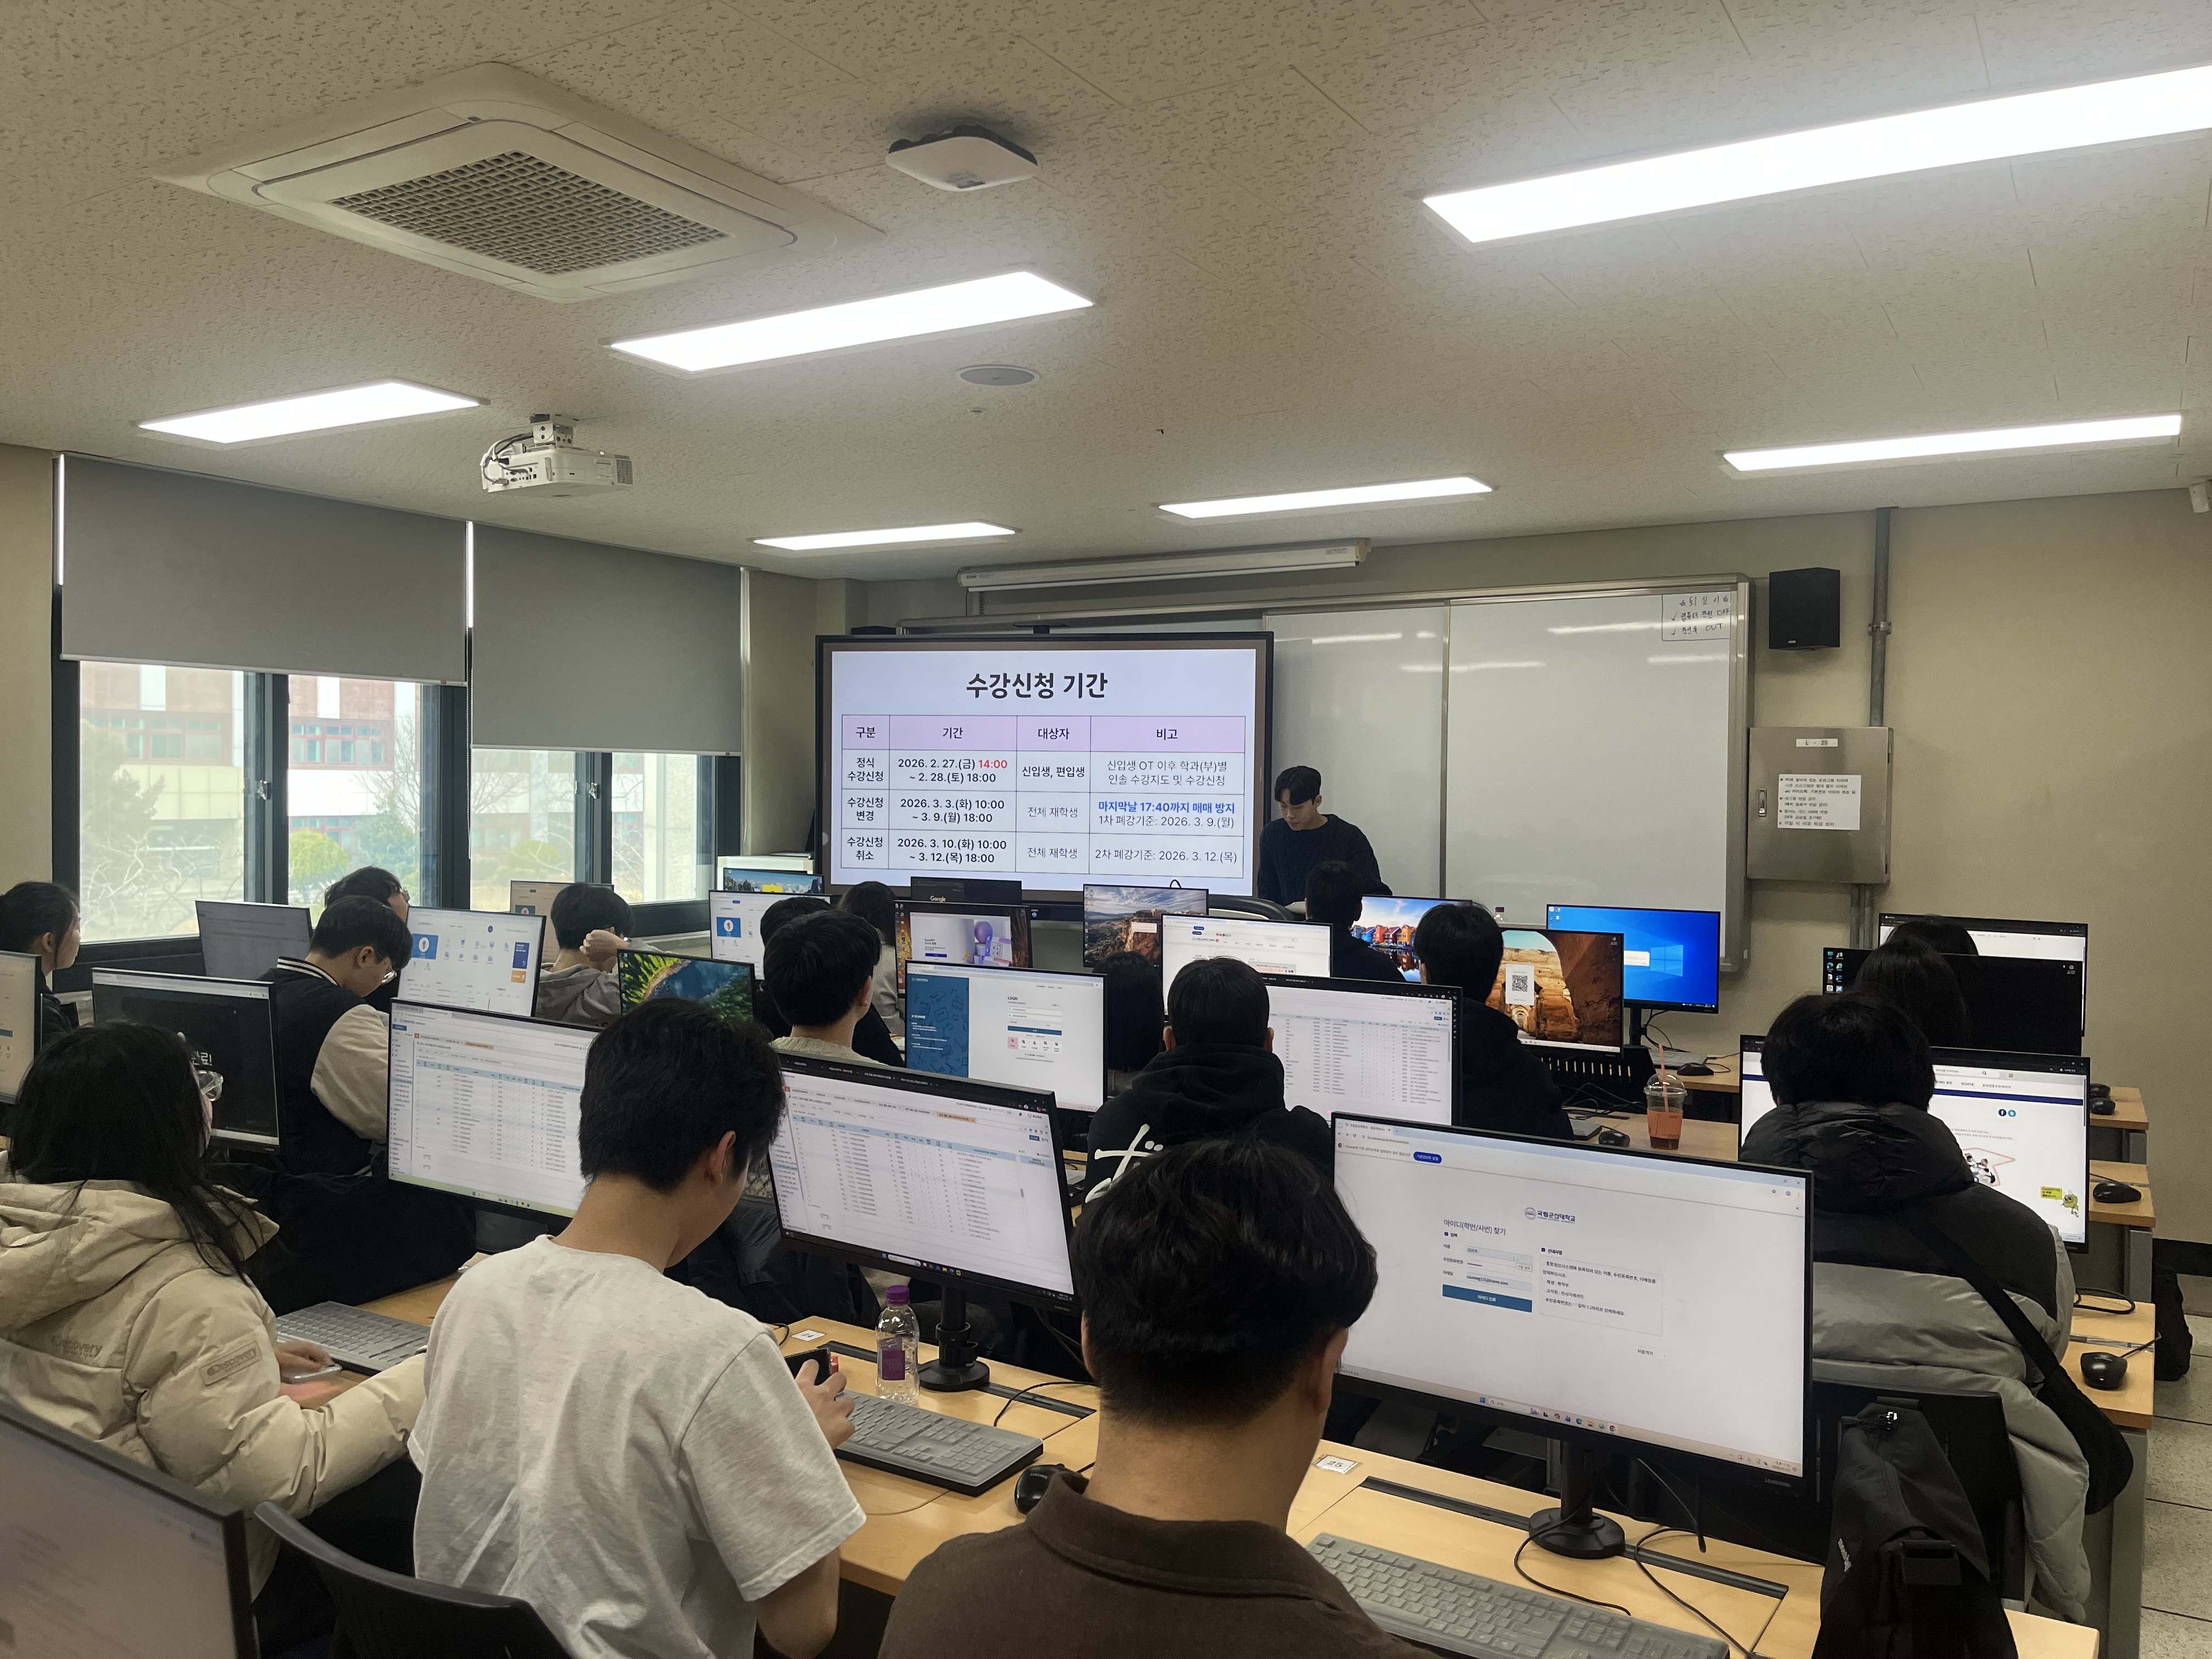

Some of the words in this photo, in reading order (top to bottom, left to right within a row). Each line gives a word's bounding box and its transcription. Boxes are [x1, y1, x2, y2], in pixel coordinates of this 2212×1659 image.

[967, 673, 1053, 699] 수강신청
[1063, 673, 1108, 698] 기간
[856, 727, 876, 738] 구분
[943, 727, 963, 738] 기간
[1038, 728, 1069, 740] 대상자
[1157, 729, 1178, 740] 비고
[857, 758, 874, 768] 정식
[898, 759, 927, 768] 2026.
[930, 759, 939, 768] 2.
[943, 759, 975, 770] 27.(금)
[979, 760, 1007, 768] 14:00
[1108, 760, 1135, 771] 신입생
[1139, 761, 1154, 770] OT
[1158, 761, 1176, 771] 이후
[1180, 761, 1226, 773] 학과(부)별
[848, 771, 883, 781] 수강신청
[1022, 766, 1053, 778] 신입생,
[1056, 766, 1084, 777] 편입생
[919, 773, 927, 781] 2.
[930, 773, 963, 784] 28.(토)
[967, 774, 996, 782] 18:00
[1109, 775, 1127, 785] 인솔
[1131, 775, 1170, 785] 수강지도
[1173, 775, 1182, 786] 및
[1186, 775, 1224, 786] 수강신청
[847, 797, 883, 808] 수강신청
[901, 799, 929, 808] 2026.
[933, 799, 942, 808] 3.
[945, 799, 972, 810] 3.(화)
[975, 800, 1004, 809] 10:00
[1099, 801, 1137, 812] 마지막날
[1140, 802, 1189, 813] 17:40까지
[1193, 803, 1212, 814] 매매
[1215, 803, 1234, 814] 방지
[856, 810, 873, 821] 변경
[1028, 807, 1046, 817] 전체
[1049, 807, 1077, 817] 재학생
[922, 812, 930, 821] 3.
[934, 812, 960, 824] 9.(월)
[964, 814, 992, 822] 18:00
[1099, 815, 1113, 825] 1차
[1116, 815, 1157, 826] 폐강기준:
[1161, 817, 1190, 826] 2026.
[1194, 817, 1203, 826] 3.
[1207, 816, 1234, 829] 9.(월)
[847, 837, 882, 847] 수강신청
[898, 838, 927, 848] 2026.
[930, 839, 939, 848] 3.
[942, 839, 974, 851] 10.(화)
[978, 840, 1006, 849] 10:00
[856, 850, 874, 861] 취소
[919, 853, 928, 861] 3.
[931, 853, 962, 864] 12.(목)
[966, 854, 994, 862] 18:00
[1028, 848, 1045, 858] 전체
[1049, 848, 1077, 859] 재학생
[1096, 849, 1111, 859] 2차
[1114, 849, 1155, 860] 폐강기준:
[1159, 851, 1188, 860] 2026.
[1192, 852, 1201, 861] 3.
[1205, 852, 1237, 864] 12.(목)
[1538, 1210, 1575, 1221] 국립군산대학교
[1444, 1219, 1492, 1234] 아이디(학번/사번)
[1493, 1227, 1506, 1236] 찾기
